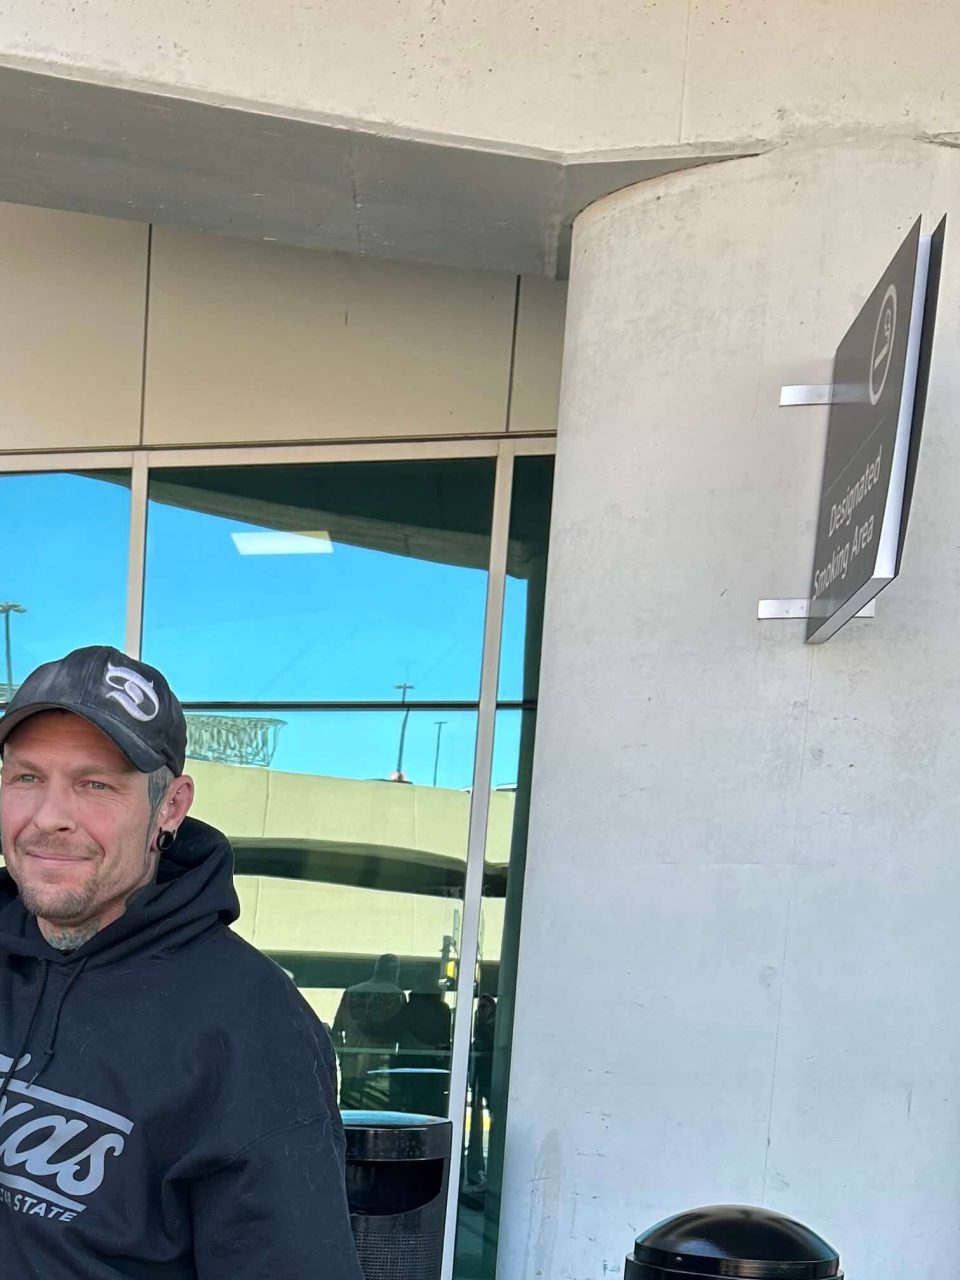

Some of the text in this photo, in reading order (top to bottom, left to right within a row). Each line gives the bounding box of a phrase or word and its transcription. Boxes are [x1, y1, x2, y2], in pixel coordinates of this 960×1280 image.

[828, 444, 883, 538] Designated
[812, 514, 875, 601] Smoking Area
[14, 1194, 78, 1222] STATE
